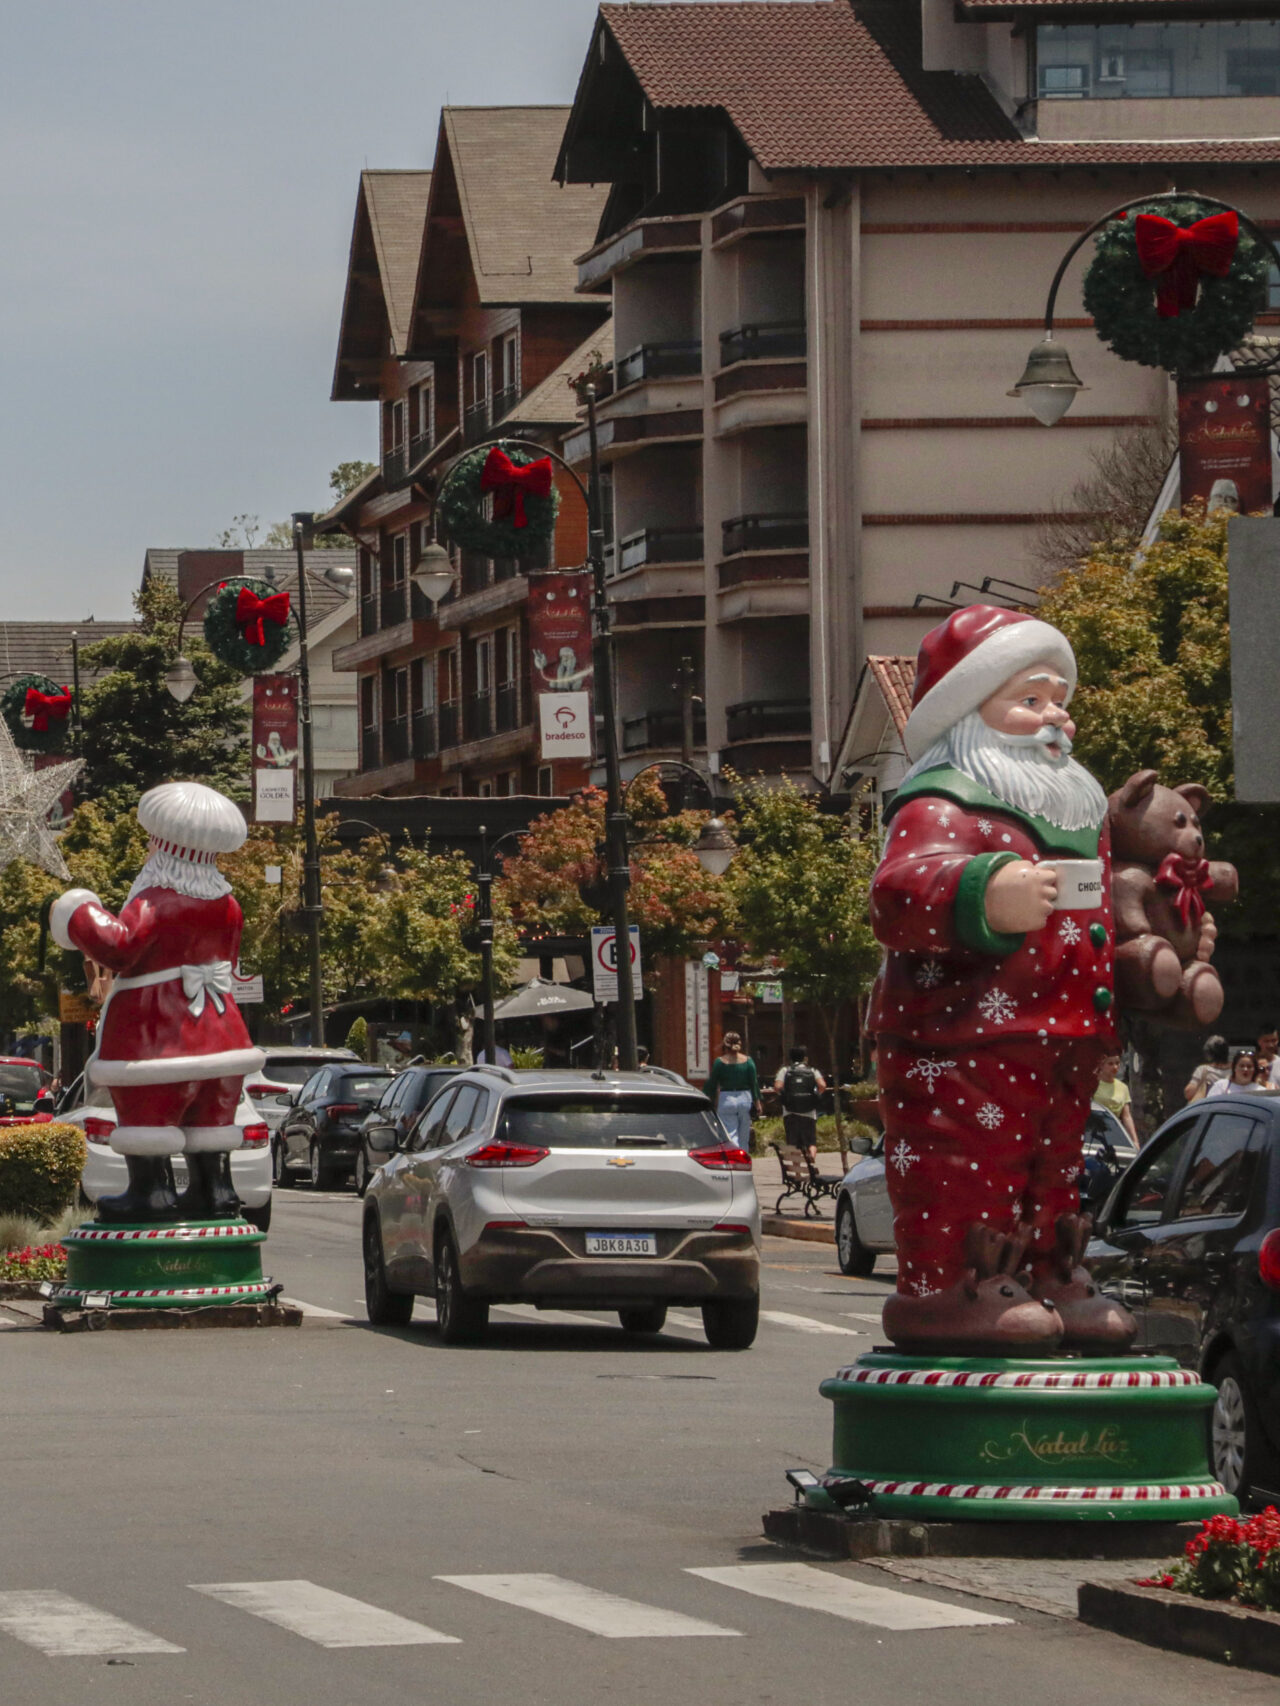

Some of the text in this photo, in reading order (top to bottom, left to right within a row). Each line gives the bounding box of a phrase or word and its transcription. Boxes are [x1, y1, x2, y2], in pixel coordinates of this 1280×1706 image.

[545, 731, 586, 741] bradesco
[593, 1239, 649, 1253] JBK8A30
[1010, 1418, 1089, 1464] Natal
